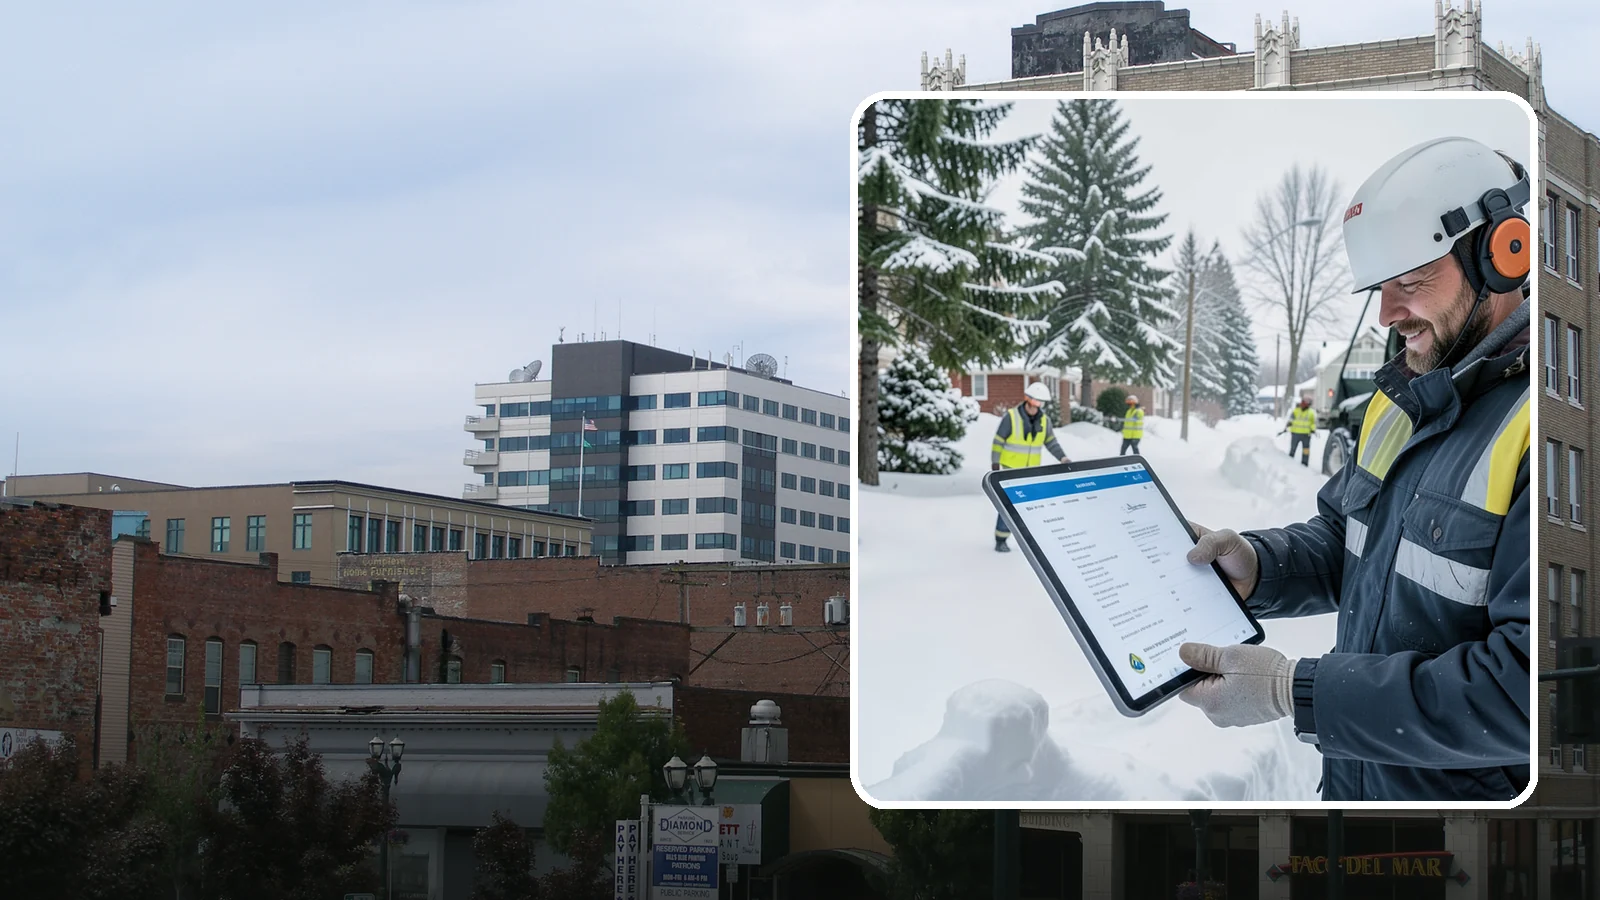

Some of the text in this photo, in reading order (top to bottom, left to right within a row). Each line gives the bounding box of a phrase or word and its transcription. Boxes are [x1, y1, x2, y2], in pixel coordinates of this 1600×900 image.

[660, 818, 713, 832] DIAMOND
[1022, 815, 1071, 828] BUILDING
[656, 845, 716, 854] RESERVED PARKING
[616, 825, 625, 894] PAY HERE
[627, 824, 637, 893] PAY HERE
[671, 862, 701, 870] PATRONS
[1289, 855, 1442, 877] TAC DEL MAR
[660, 888, 710, 898] PUBLIC PARKING
